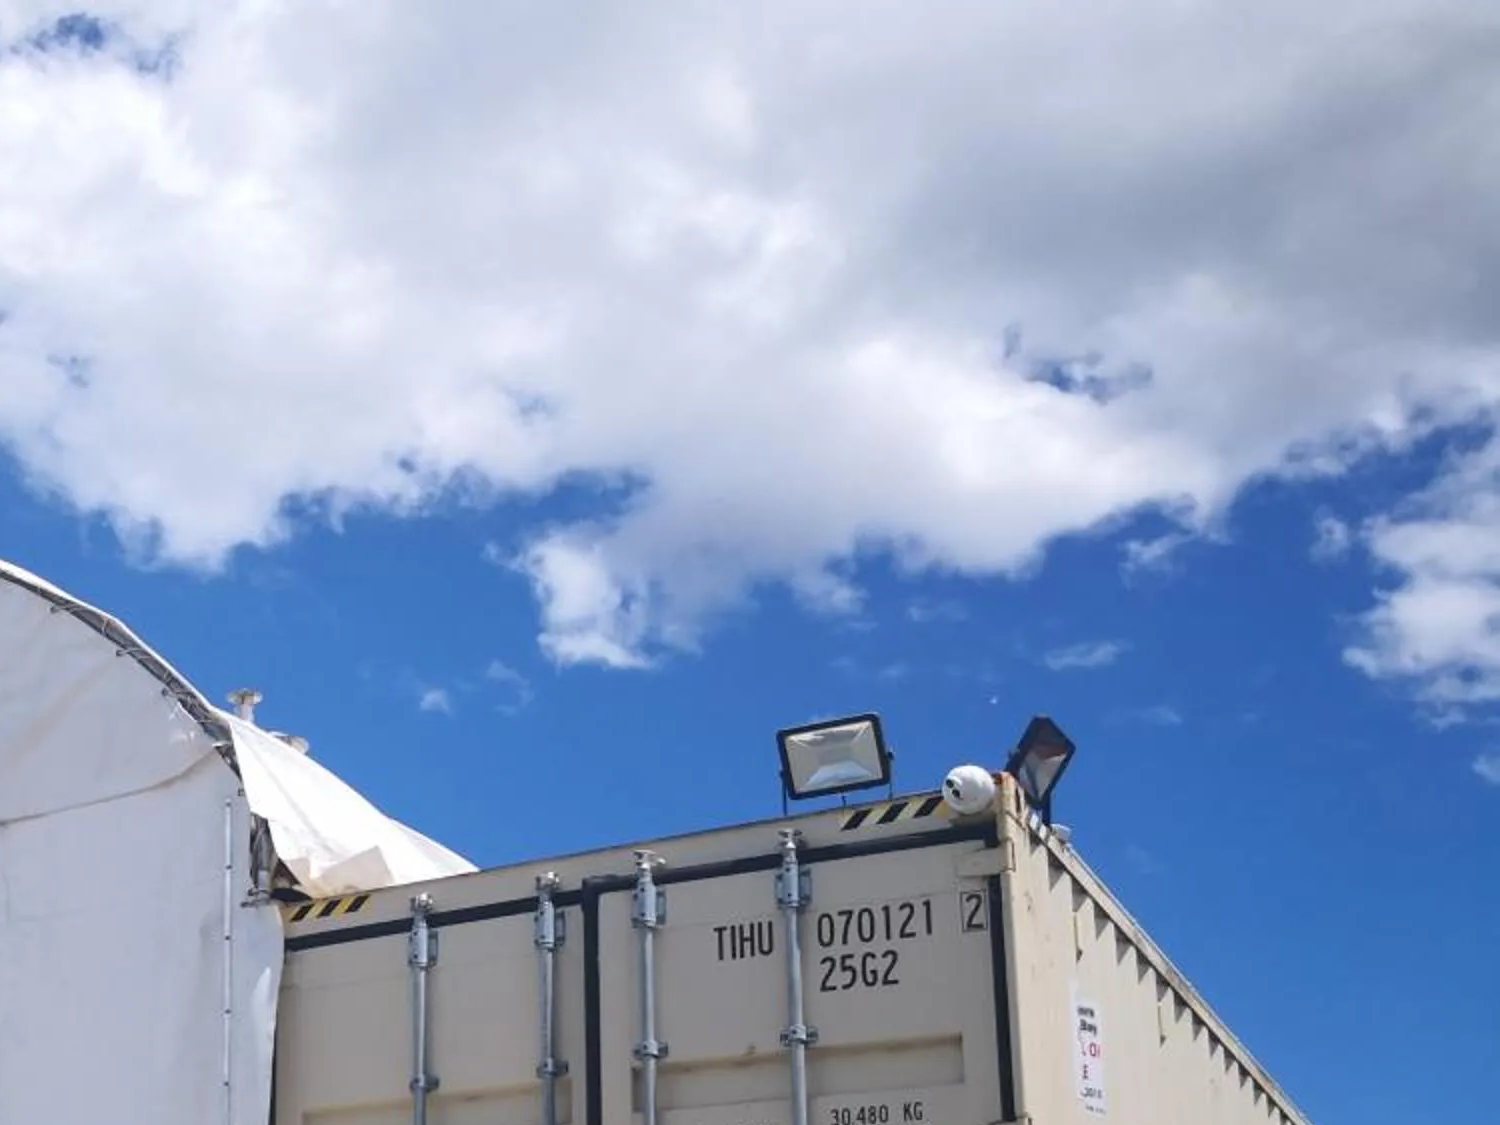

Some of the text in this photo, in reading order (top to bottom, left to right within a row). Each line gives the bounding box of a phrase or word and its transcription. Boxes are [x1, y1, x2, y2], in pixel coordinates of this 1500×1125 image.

[713, 893, 985, 961] TIHU 070121 2
[819, 949, 900, 992] 25G2
[903, 1101, 924, 1122] KG
